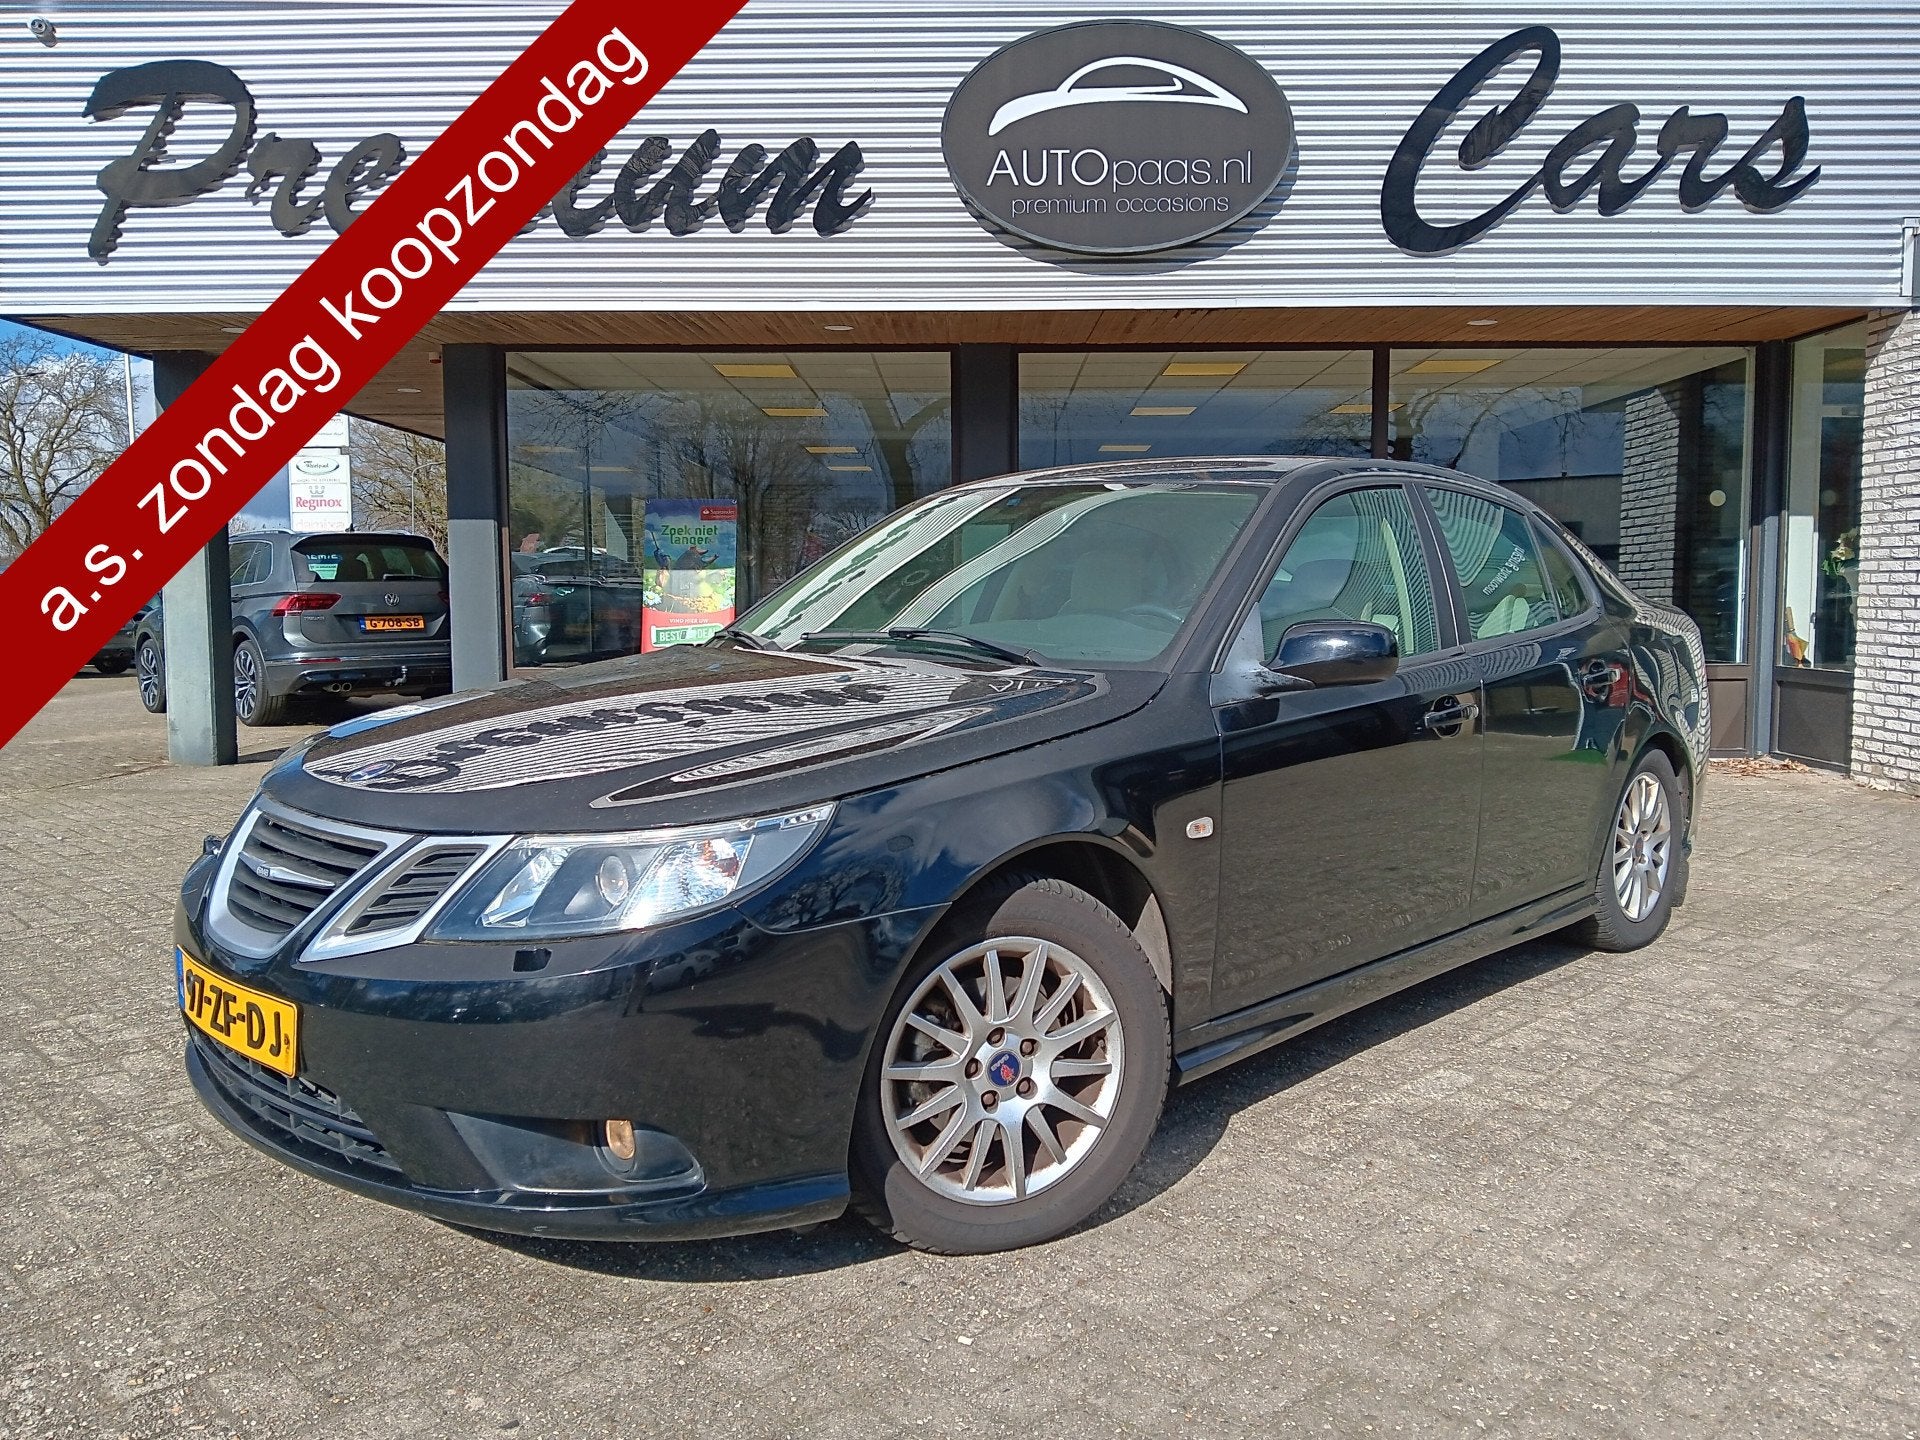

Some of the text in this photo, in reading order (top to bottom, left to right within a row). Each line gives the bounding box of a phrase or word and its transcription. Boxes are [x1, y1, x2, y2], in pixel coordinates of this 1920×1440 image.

[1381, 26, 1821, 256] Cars
[986, 148, 1253, 192] AUTOpaas.nl
[1011, 193, 1230, 218] premium occasions
[295, 496, 342, 511] Reginox
[661, 524, 718, 536] Zoek niet
[369, 617, 420, 629] G-708-SB
[660, 630, 679, 642] BEST
[186, 968, 282, 1058] 97-ZF-DJ
